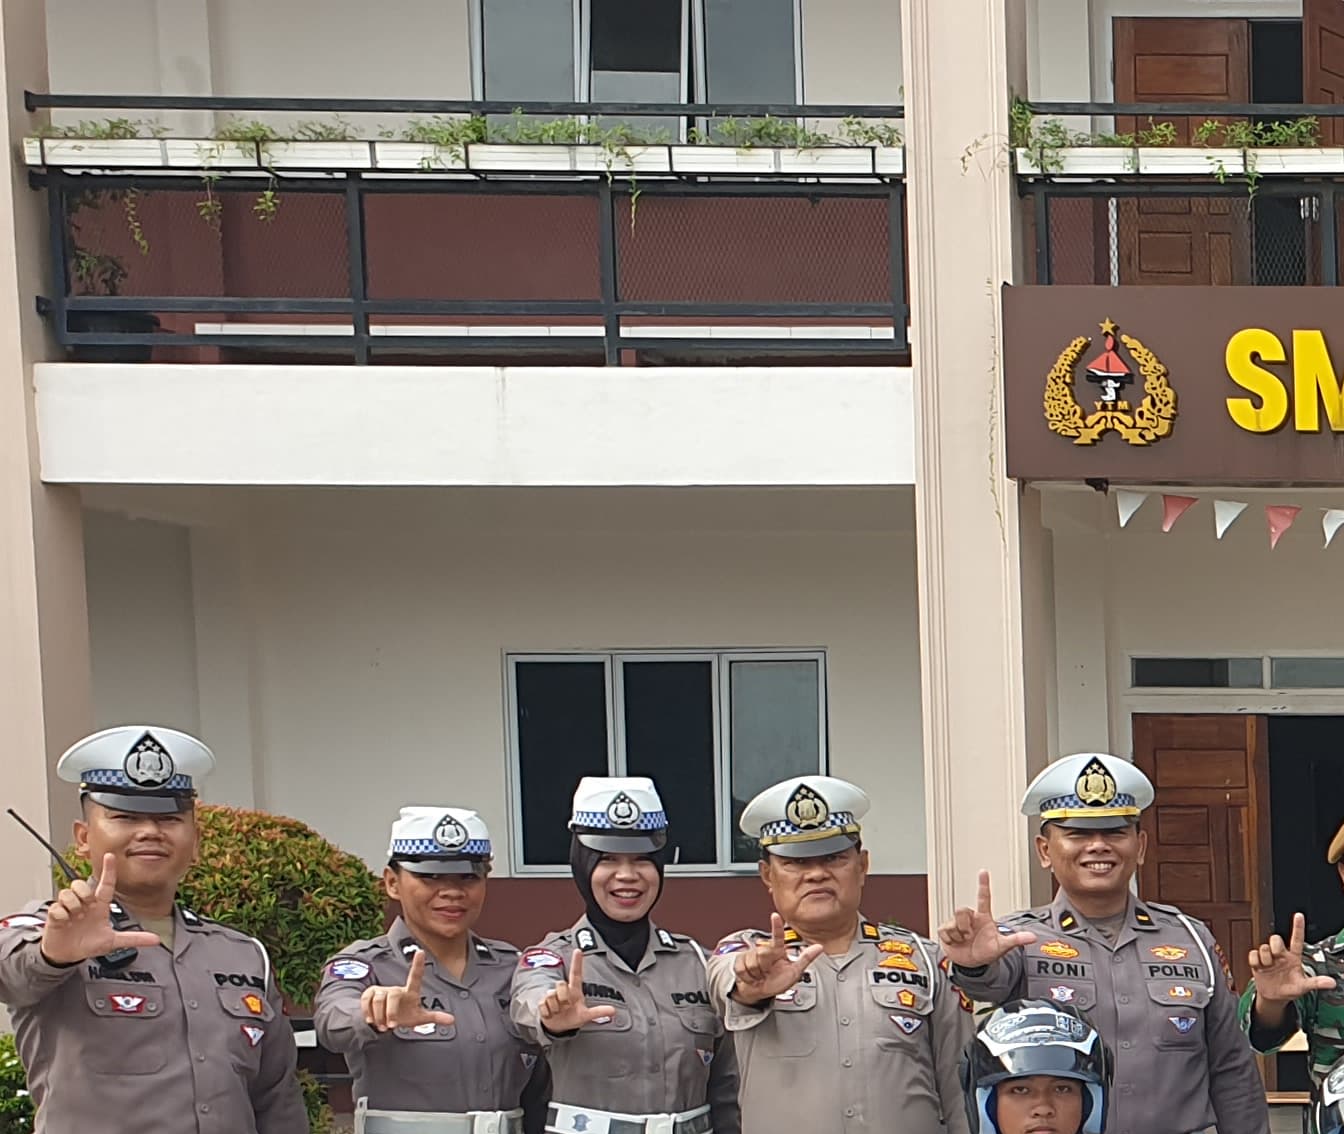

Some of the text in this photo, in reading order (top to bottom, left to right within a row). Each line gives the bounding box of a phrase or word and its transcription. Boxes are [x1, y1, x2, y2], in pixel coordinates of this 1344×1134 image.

[1037, 960, 1086, 977] RONI
[1149, 965, 1199, 979] POLRI
[874, 970, 928, 988] POLRI
